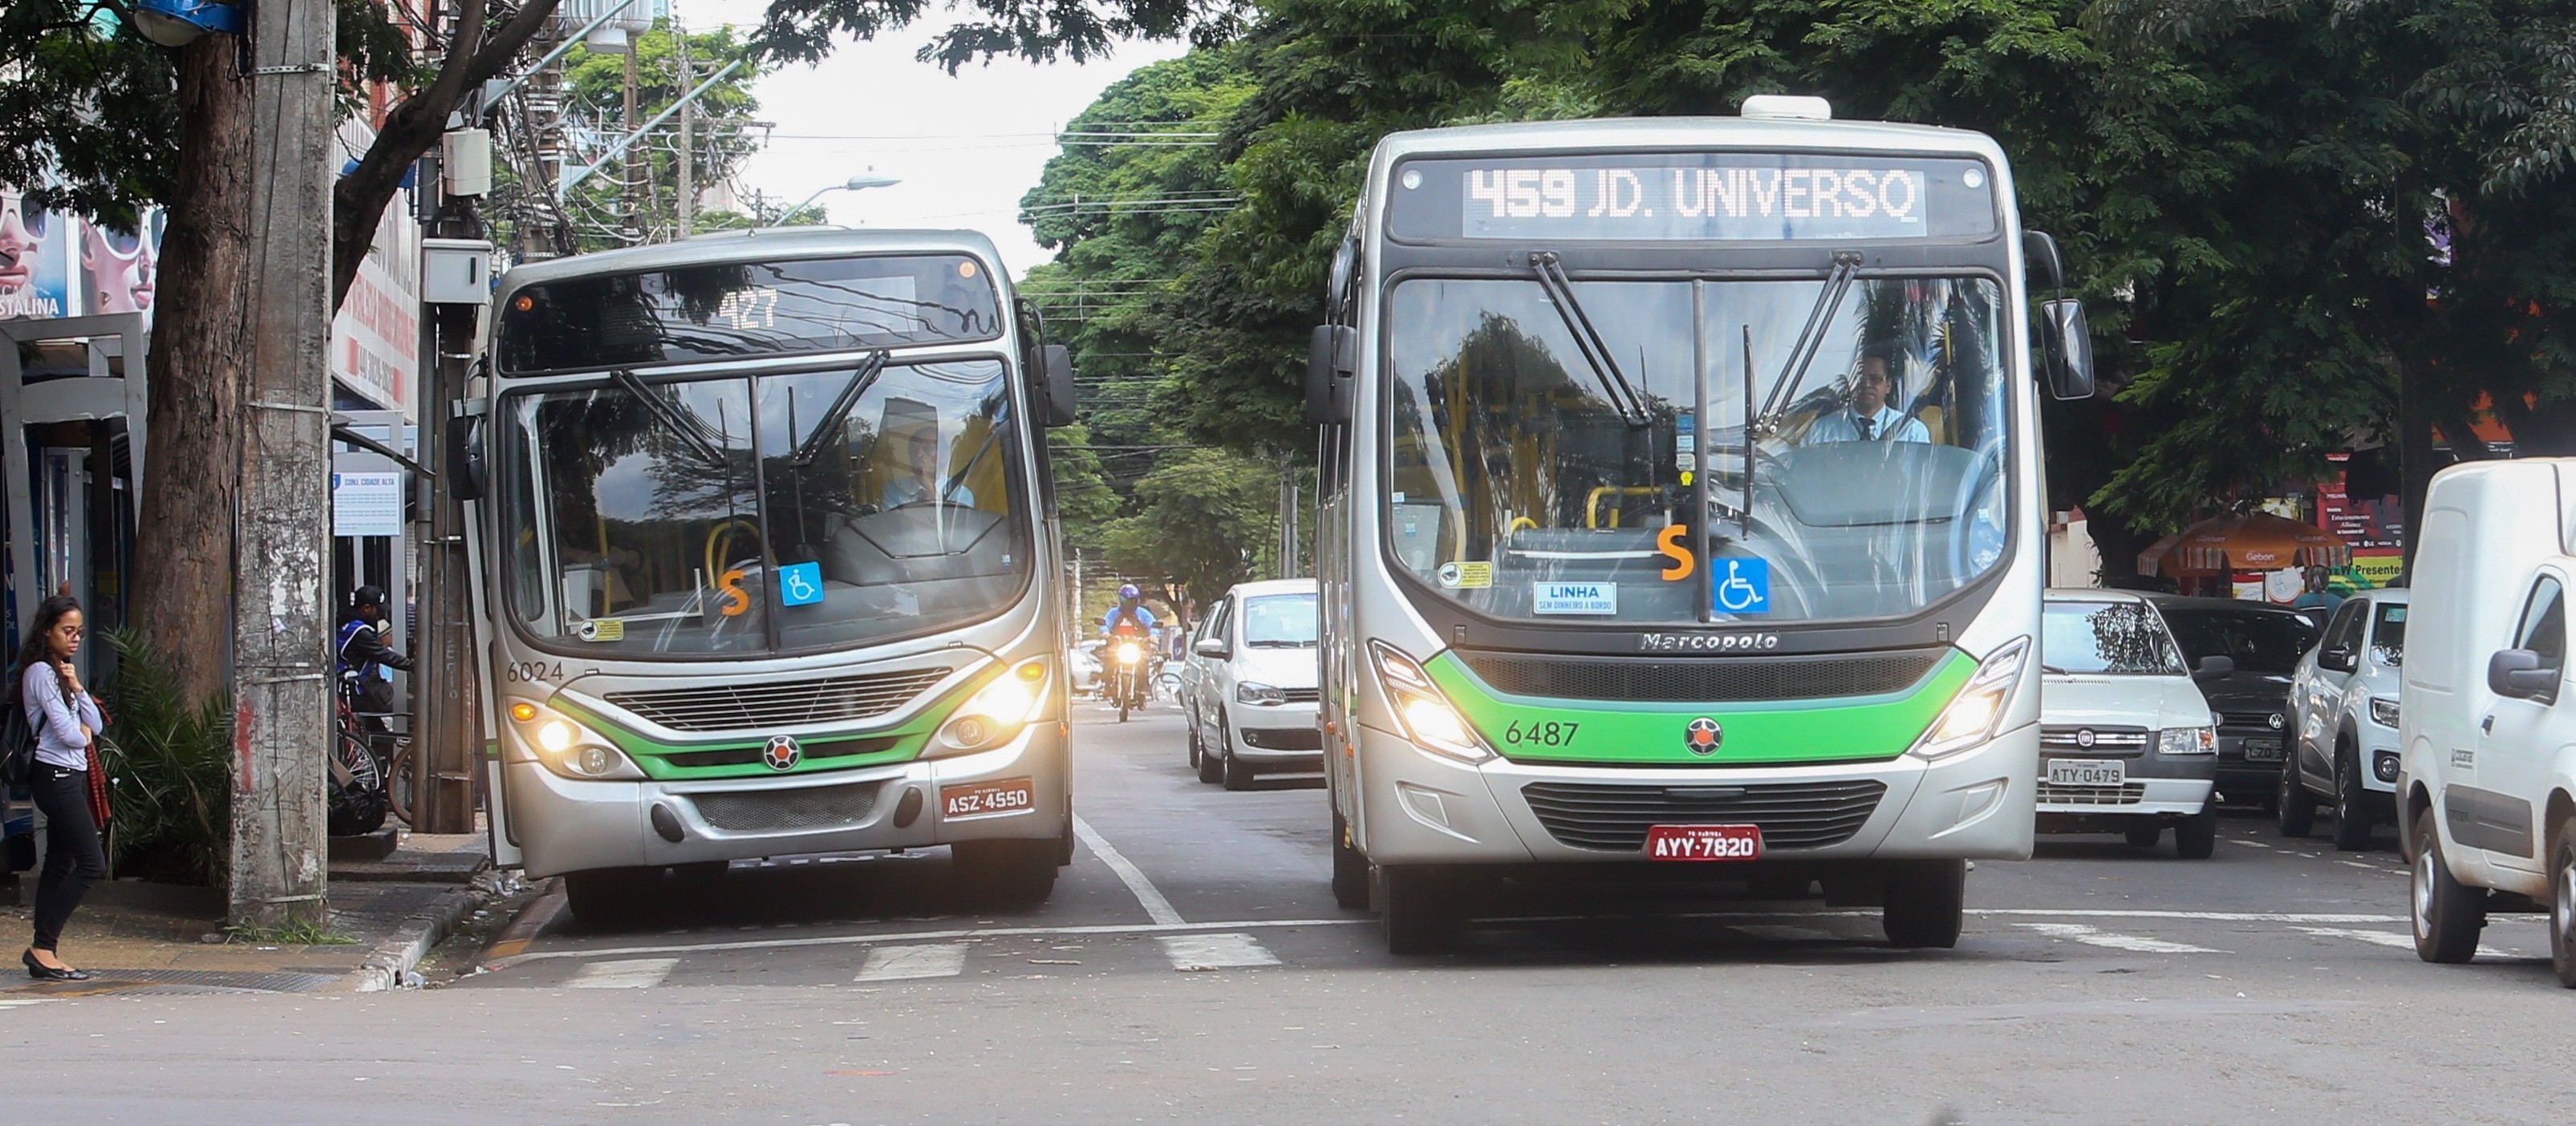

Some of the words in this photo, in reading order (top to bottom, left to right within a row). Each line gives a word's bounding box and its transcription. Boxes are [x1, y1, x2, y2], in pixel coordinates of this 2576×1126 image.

[1471, 169, 1575, 217] 459
[1588, 169, 1653, 217] JD.
[1675, 169, 1916, 217] UNIVERSO
[719, 289, 777, 330] 427
[361, 478, 380, 486] CIDADE
[382, 478, 395, 486] ALTA
[1657, 524, 1694, 581] S
[720, 569, 750, 616] S
[1550, 586, 1600, 598] LINHA
[1539, 601, 1552, 610] SEM
[1554, 601, 1583, 610] DINHEIRO
[1584, 601, 1589, 610] A
[1591, 601, 1612, 610] BORDO
[1640, 633, 1778, 652] Marcopolo
[507, 660, 564, 683] 6024
[1505, 719, 1580, 747] 6487
